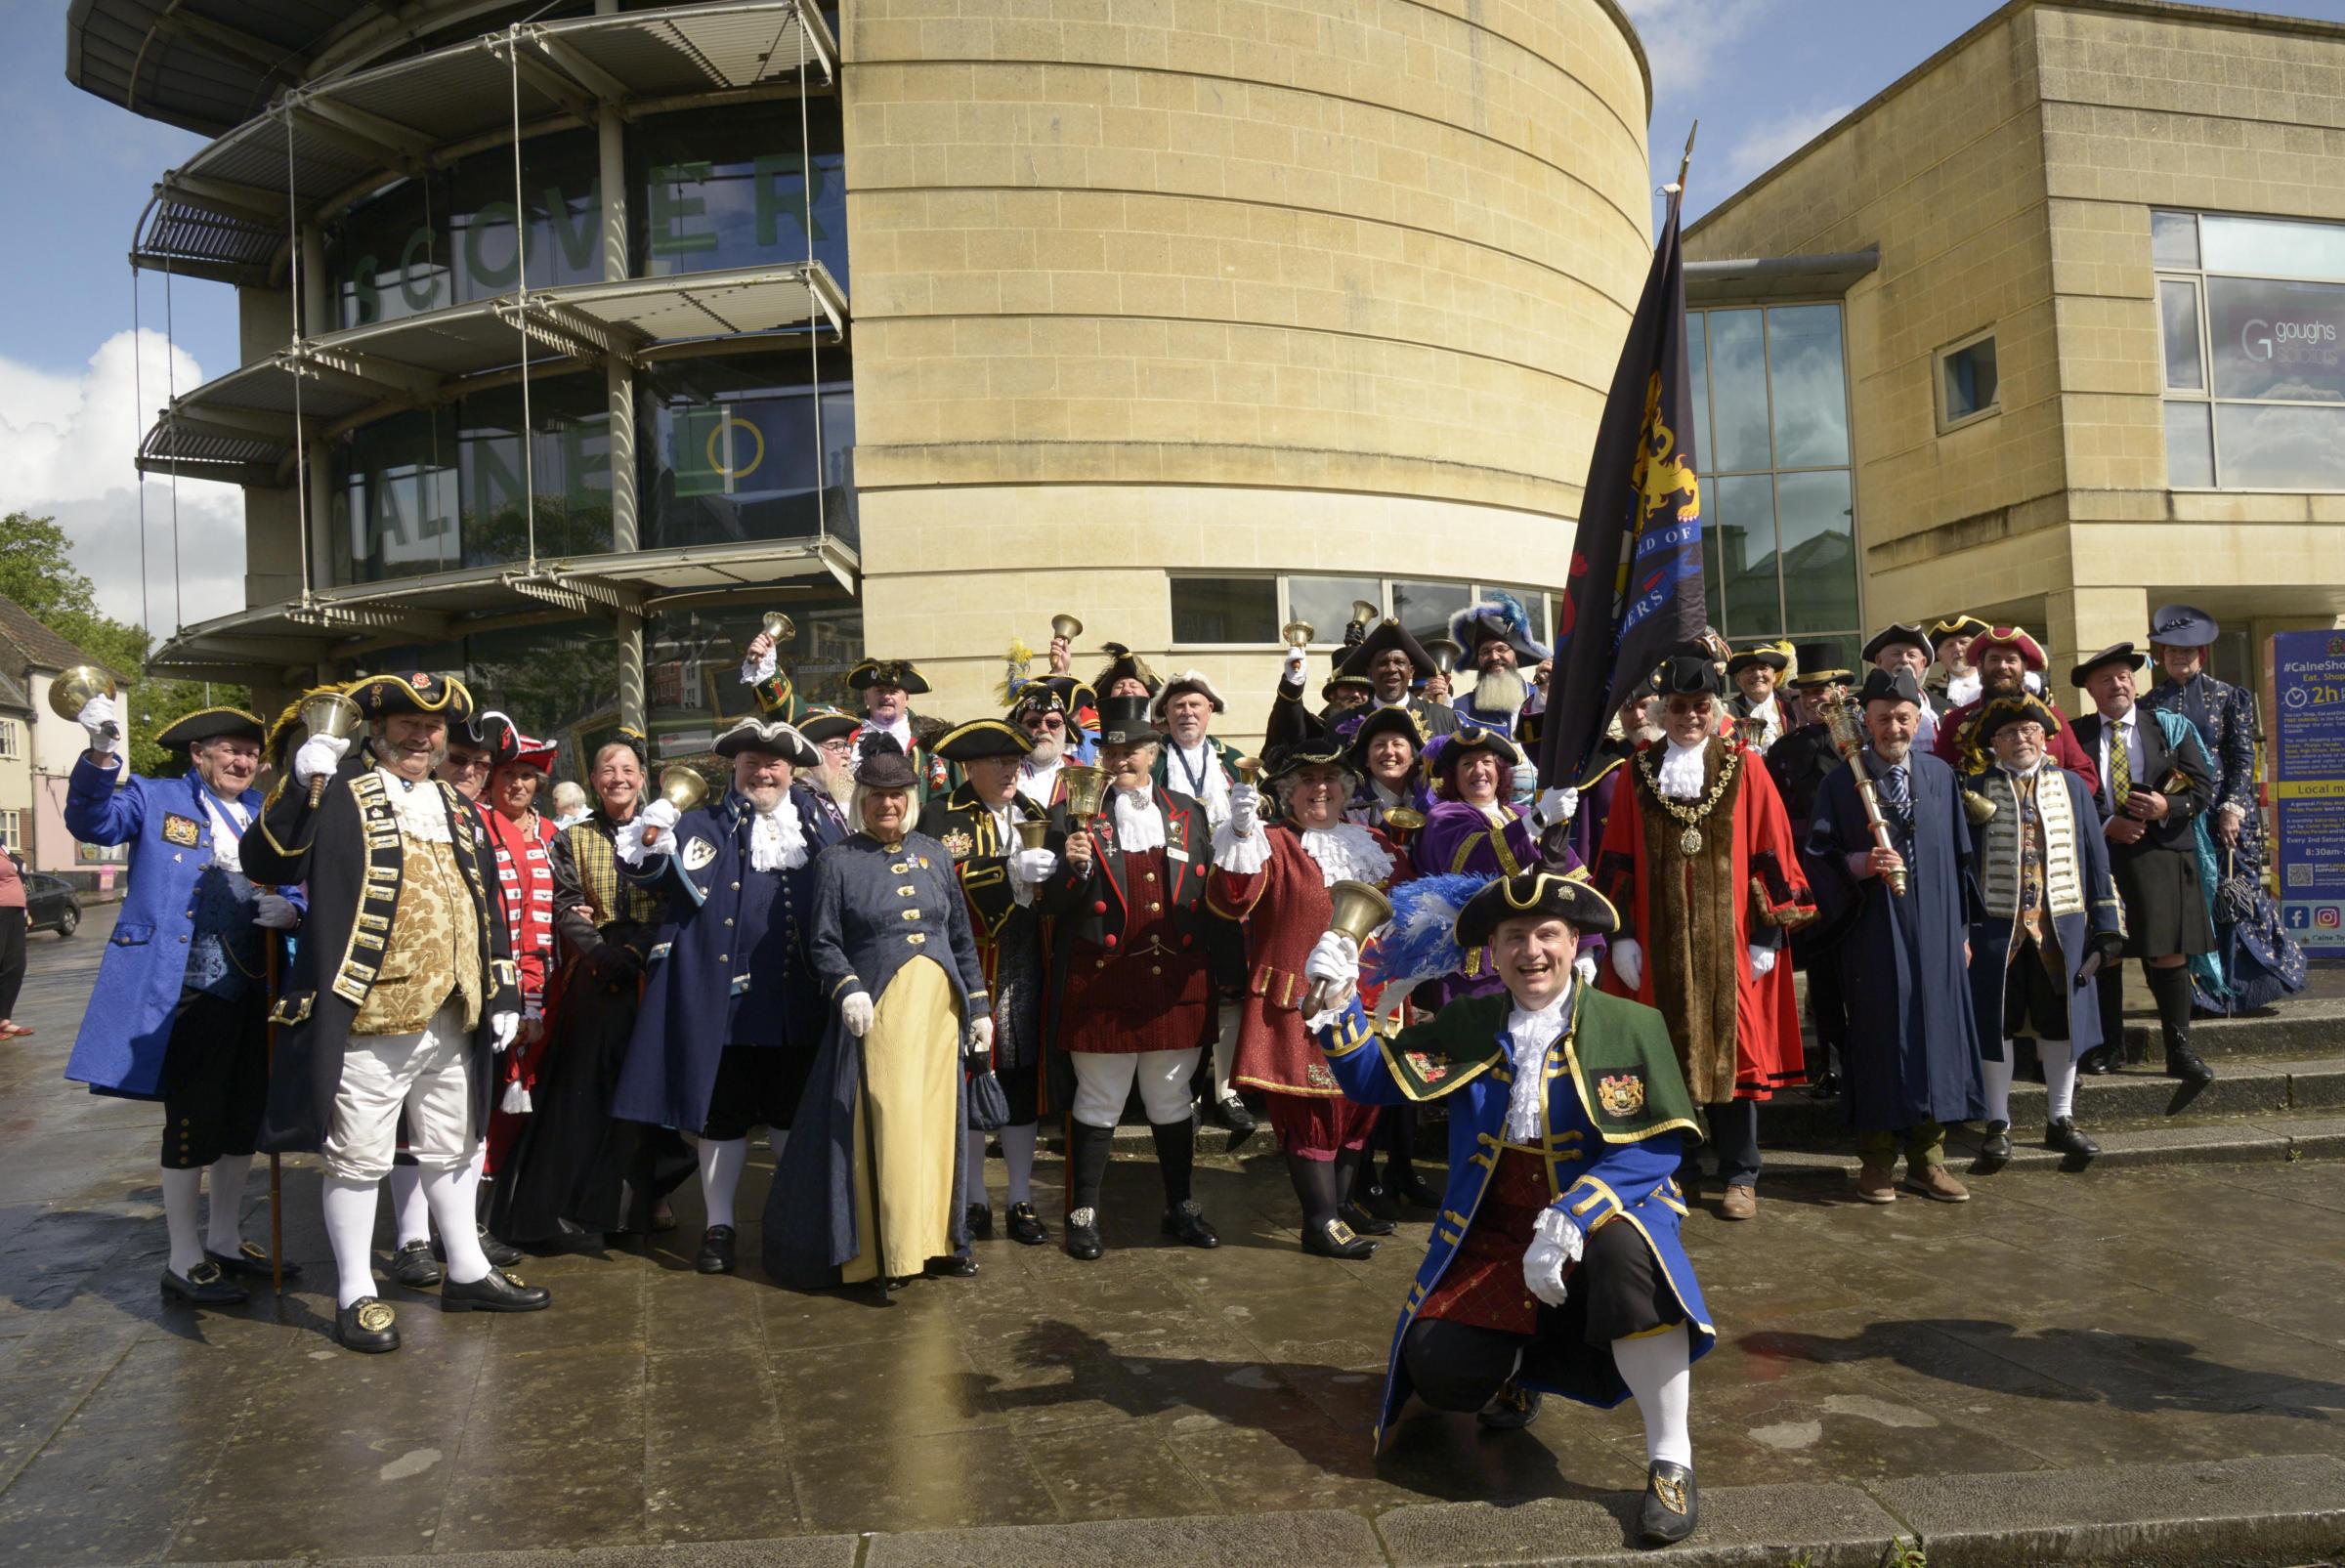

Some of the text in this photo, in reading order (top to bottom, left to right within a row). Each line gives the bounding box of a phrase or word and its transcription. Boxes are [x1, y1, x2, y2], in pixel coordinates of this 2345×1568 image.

[2276, 320, 2336, 344] goughs
[1665, 527, 1691, 543] OF
[2312, 685, 2339, 703] 2h
[2298, 784, 2329, 794] Local
